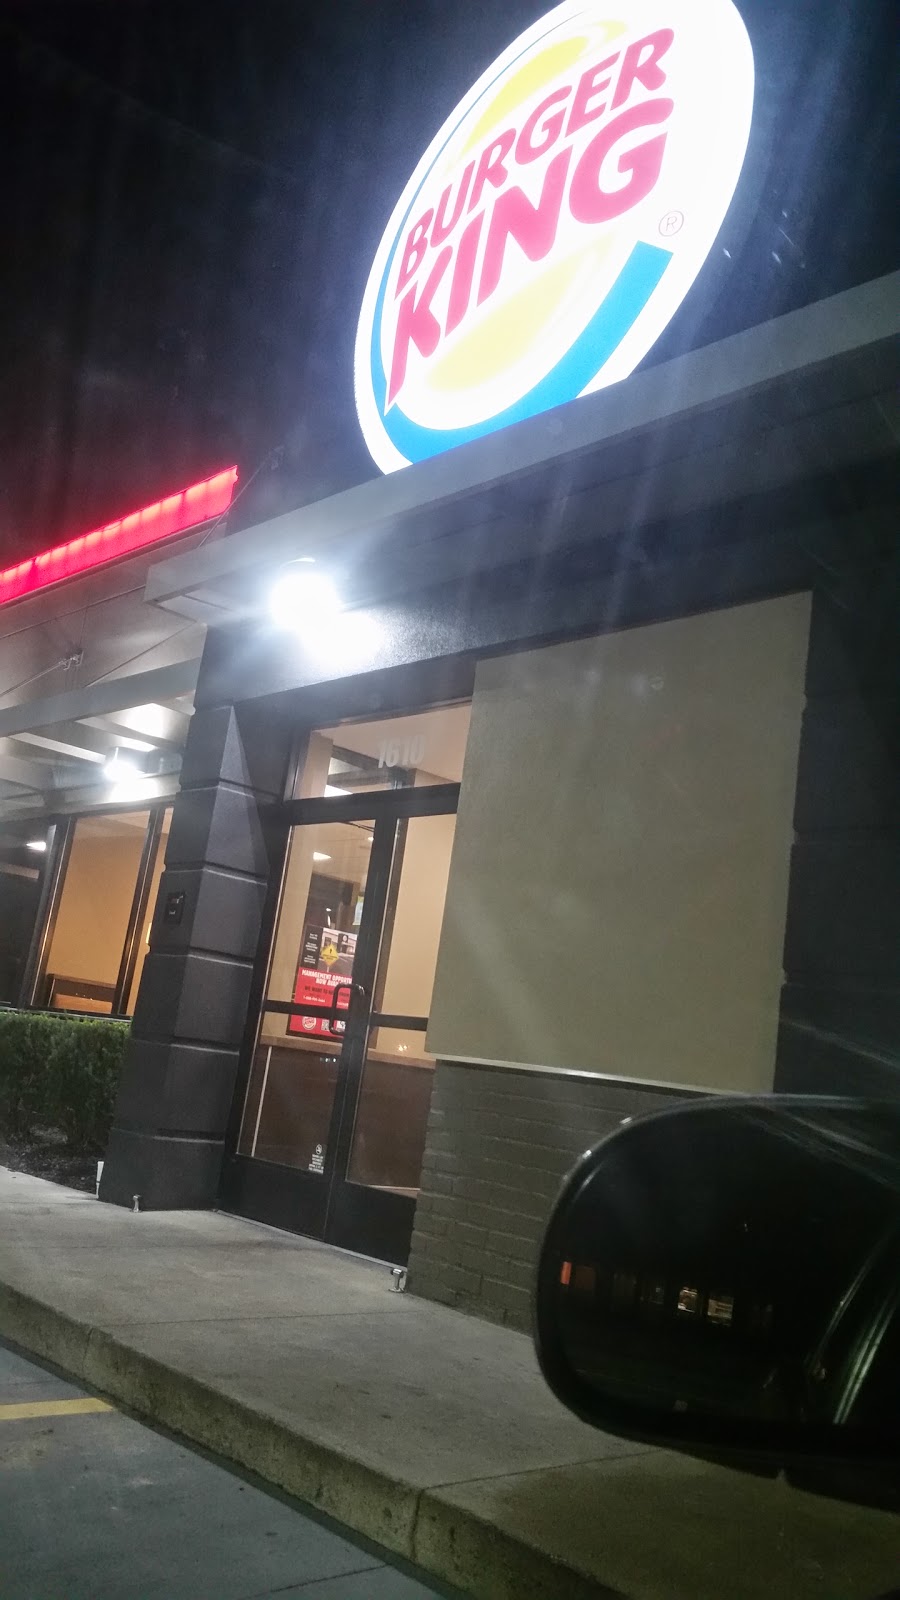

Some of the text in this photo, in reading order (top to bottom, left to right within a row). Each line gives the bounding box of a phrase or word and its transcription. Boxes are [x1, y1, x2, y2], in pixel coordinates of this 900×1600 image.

[387, 98, 674, 407] KING
[395, 28, 674, 300] BURGER
[301, 969, 332, 980] MANAGEMENT
